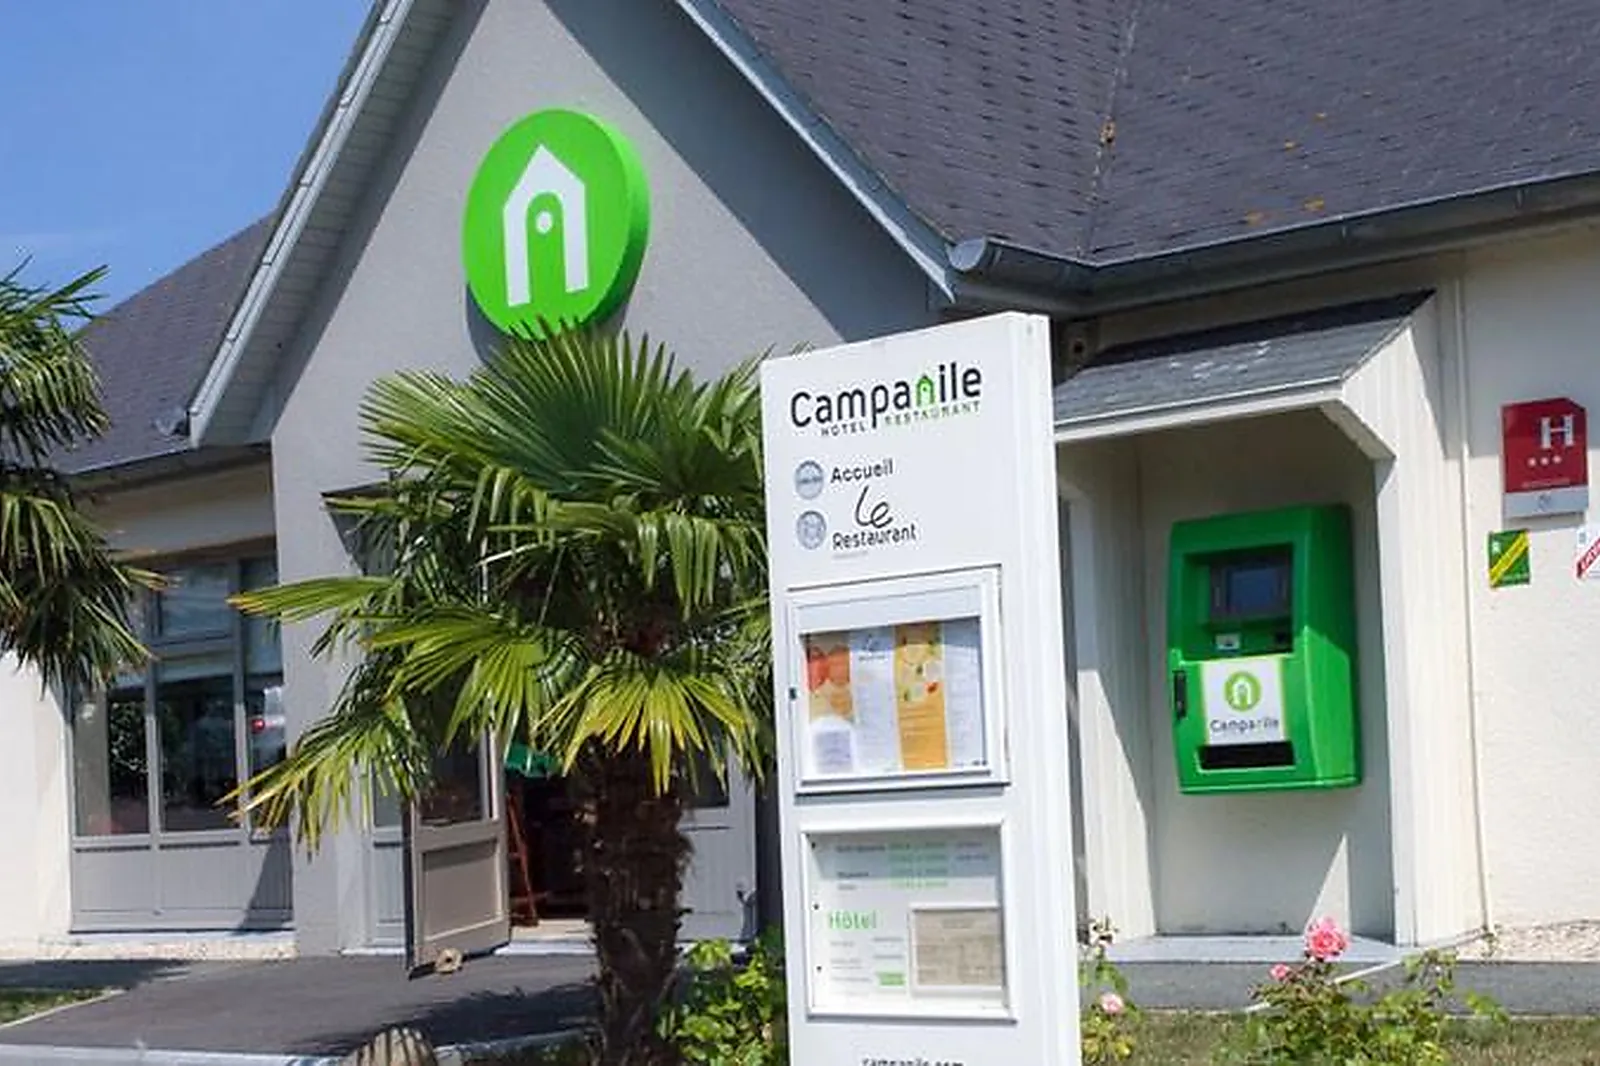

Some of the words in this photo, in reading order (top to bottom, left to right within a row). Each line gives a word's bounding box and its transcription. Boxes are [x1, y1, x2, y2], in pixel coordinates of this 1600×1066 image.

[791, 362, 982, 429] Campanile
[884, 401, 980, 426] RESTAURANT
[1540, 414, 1575, 449] H
[830, 458, 894, 483] Accueil
[855, 485, 894, 529] Le
[832, 523, 917, 550] Restaurant
